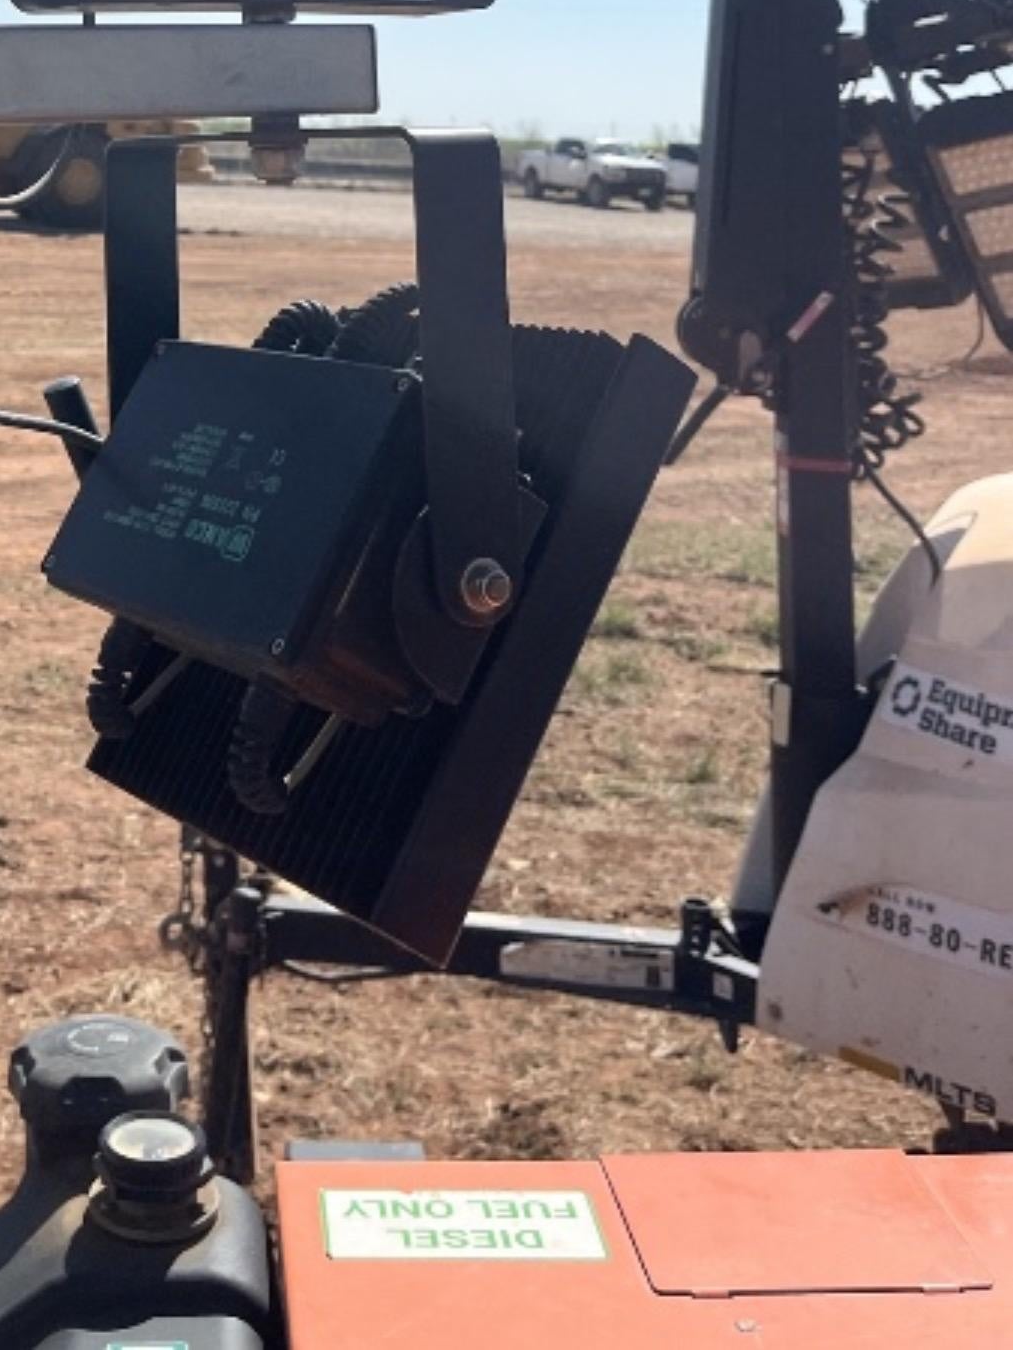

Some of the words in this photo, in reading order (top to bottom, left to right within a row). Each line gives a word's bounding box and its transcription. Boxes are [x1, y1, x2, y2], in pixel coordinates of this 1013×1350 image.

[917, 707, 997, 754] Share
[343, 1199, 454, 1219] ONLY
[466, 1199, 578, 1219] FUEL
[385, 1229, 544, 1249] DIESEL
